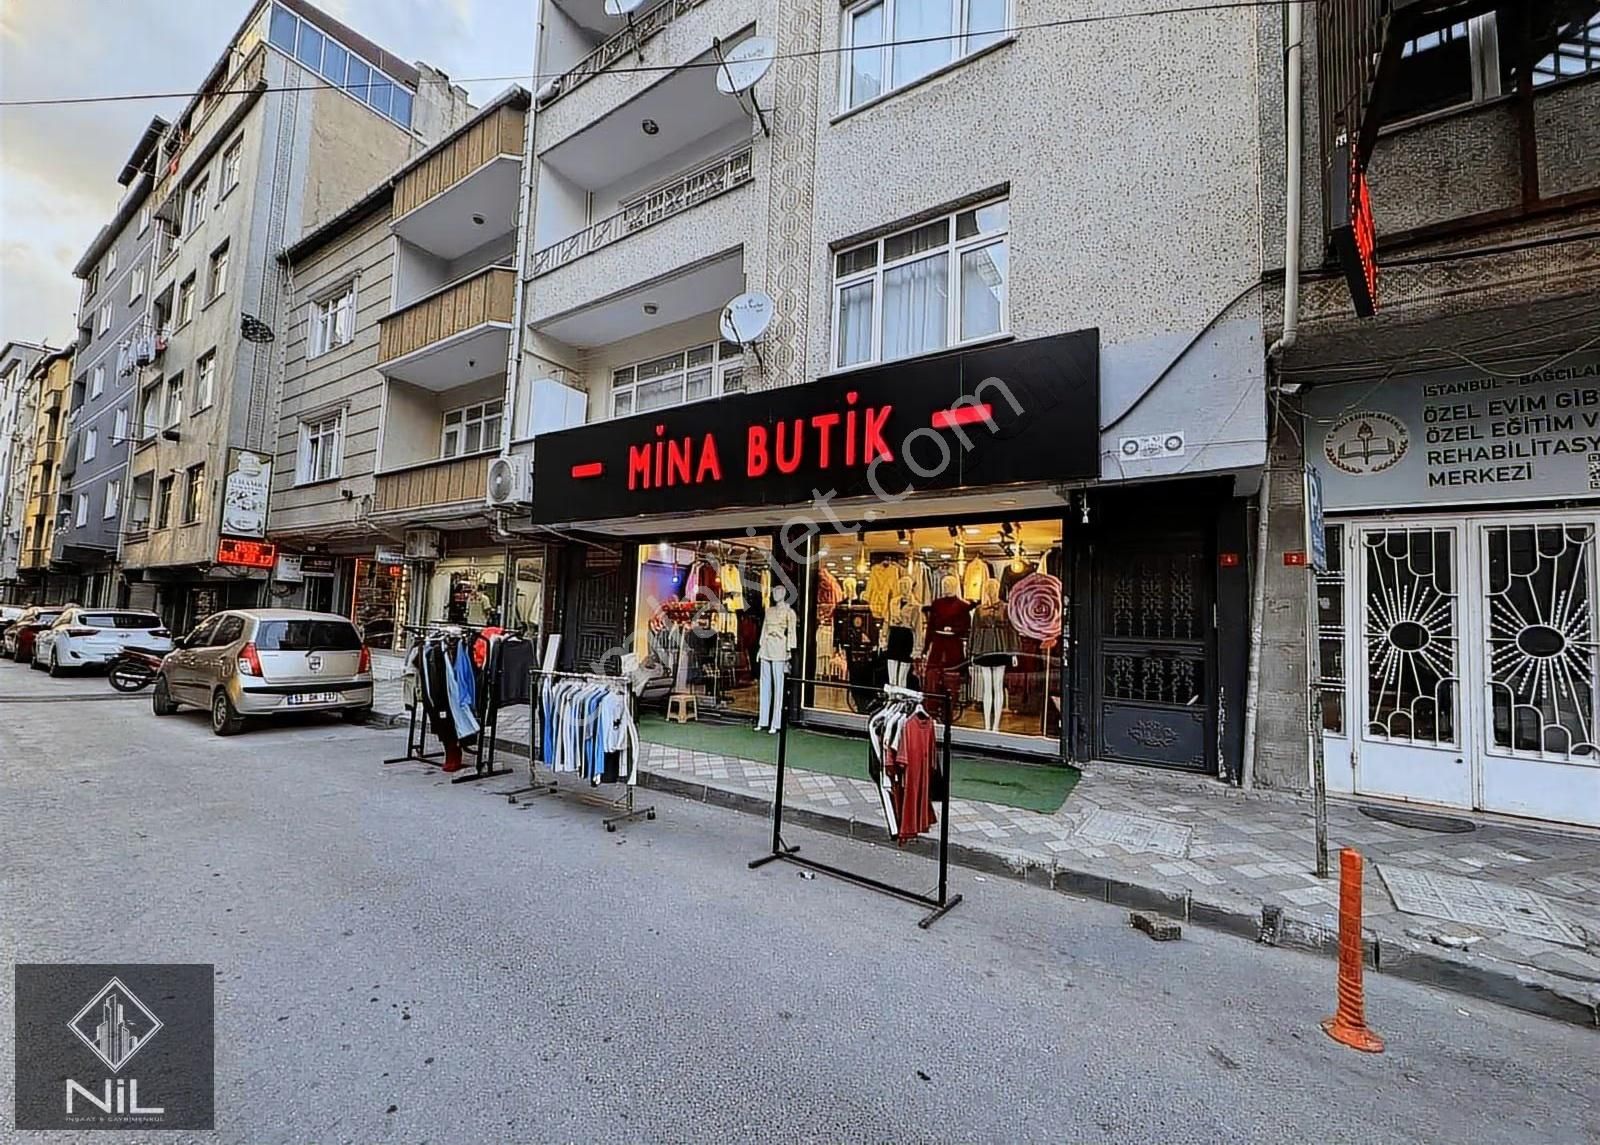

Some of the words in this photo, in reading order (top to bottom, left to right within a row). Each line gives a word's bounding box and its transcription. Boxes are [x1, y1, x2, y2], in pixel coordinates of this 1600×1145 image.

[1424, 404, 1481, 423] ÖZEL
[1488, 395, 1546, 417] EVİM
[628, 424, 721, 490] MİNA
[747, 391, 894, 477] BUTİK
[1426, 426, 1484, 444] ÖZEL
[1491, 414, 1574, 437] EĞİTİM
[1428, 462, 1532, 487] MERKEZİ
